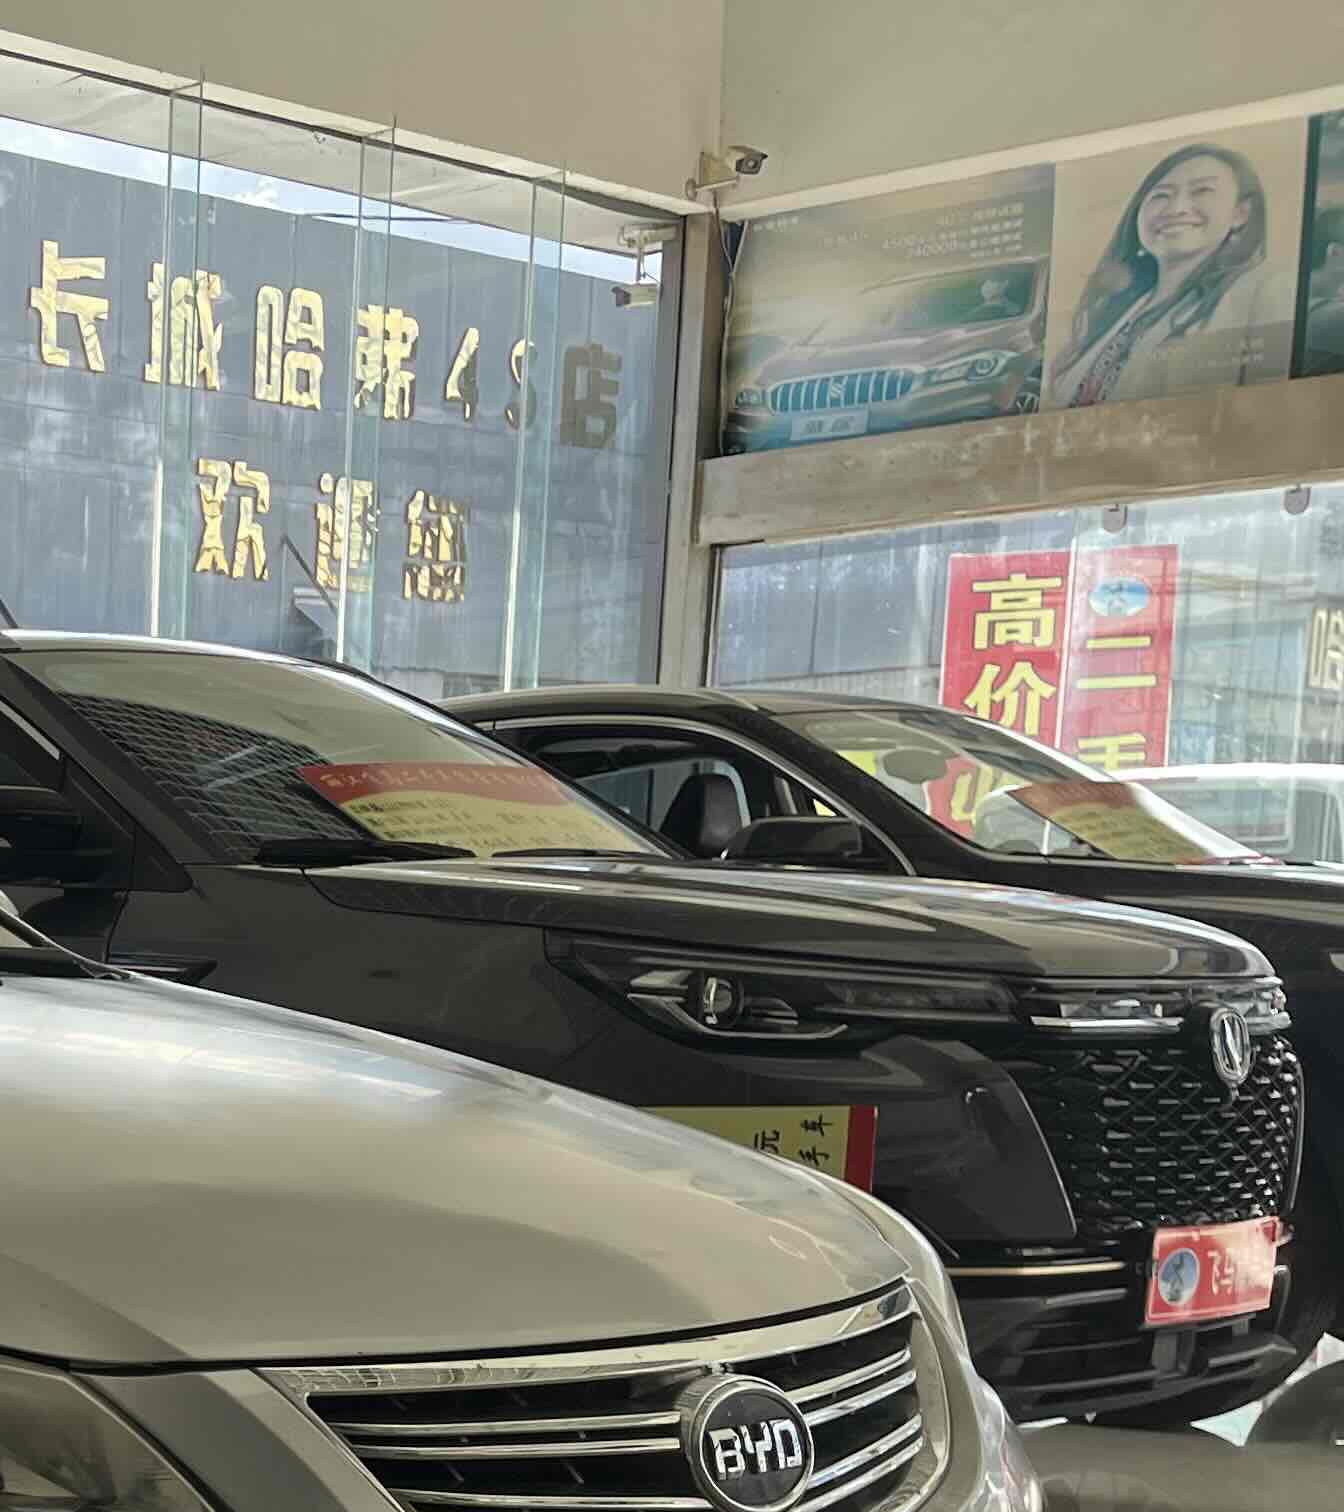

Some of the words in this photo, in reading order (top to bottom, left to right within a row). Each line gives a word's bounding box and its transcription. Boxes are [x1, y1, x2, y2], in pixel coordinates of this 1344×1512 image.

[195, 458, 468, 602] 欢迎您
[709, 1419, 803, 1480] BYD
